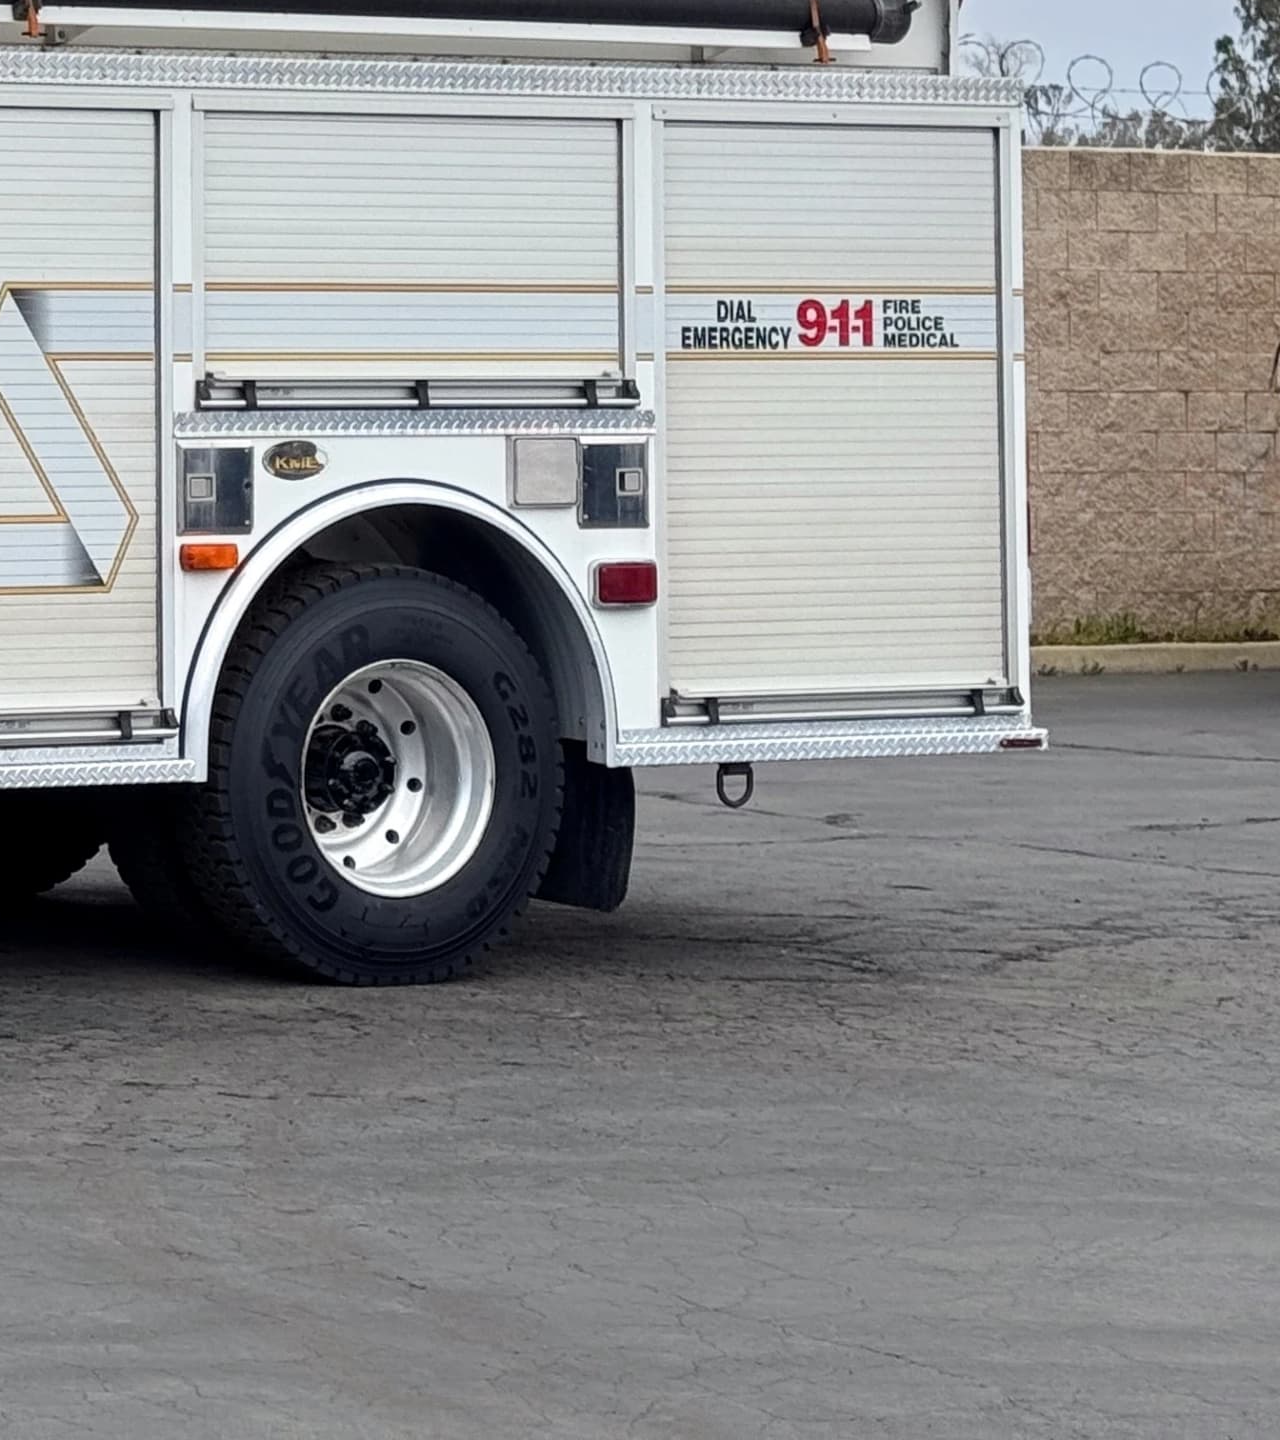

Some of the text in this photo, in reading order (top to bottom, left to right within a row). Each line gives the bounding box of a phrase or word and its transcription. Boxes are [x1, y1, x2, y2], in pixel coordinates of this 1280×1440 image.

[717, 300, 757, 323] DIAL
[882, 300, 921, 314] FIRE
[796, 299, 873, 347] 9-1-1
[882, 316, 944, 331] POLICE
[681, 326, 791, 349] EMERGENCY
[882, 332, 959, 347] MEDICAL
[264, 623, 371, 913] GOODYEAR
